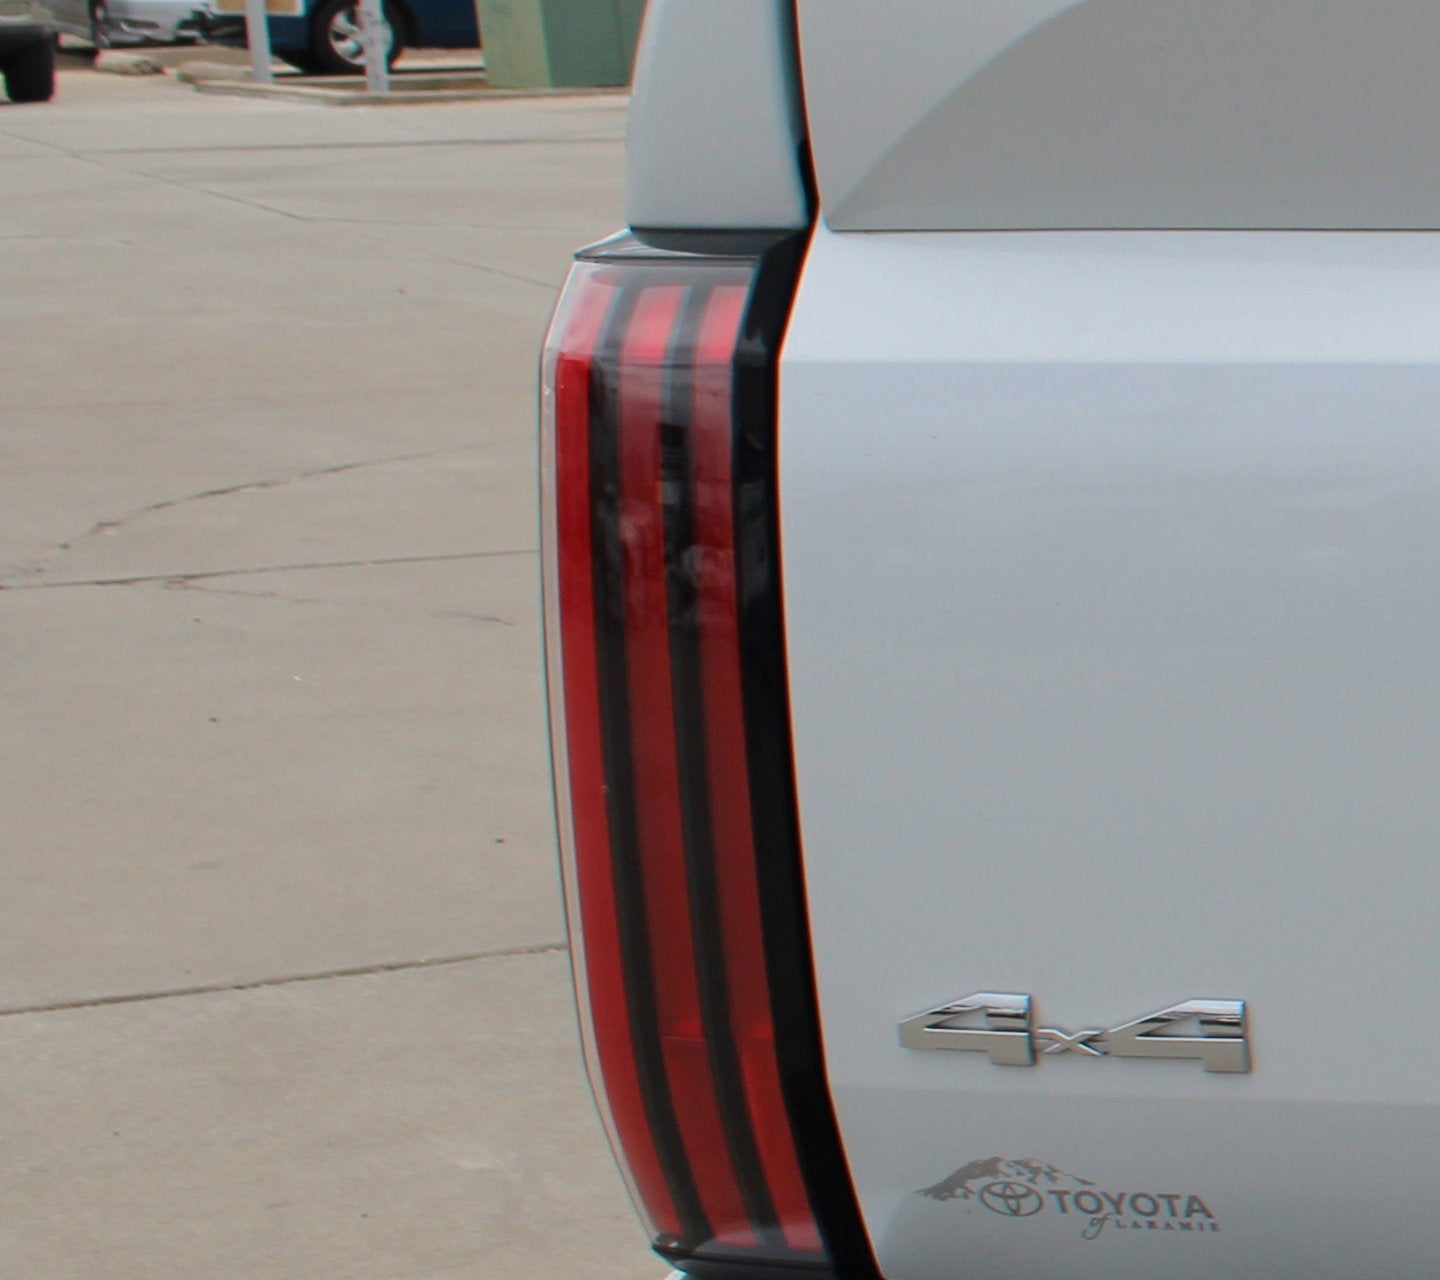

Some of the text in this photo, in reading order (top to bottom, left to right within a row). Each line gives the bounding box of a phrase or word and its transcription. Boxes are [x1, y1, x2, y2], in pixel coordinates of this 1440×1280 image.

[1047, 1189, 1216, 1219] TOYOTA
[1082, 1212, 1222, 1240] of LARAMIE
